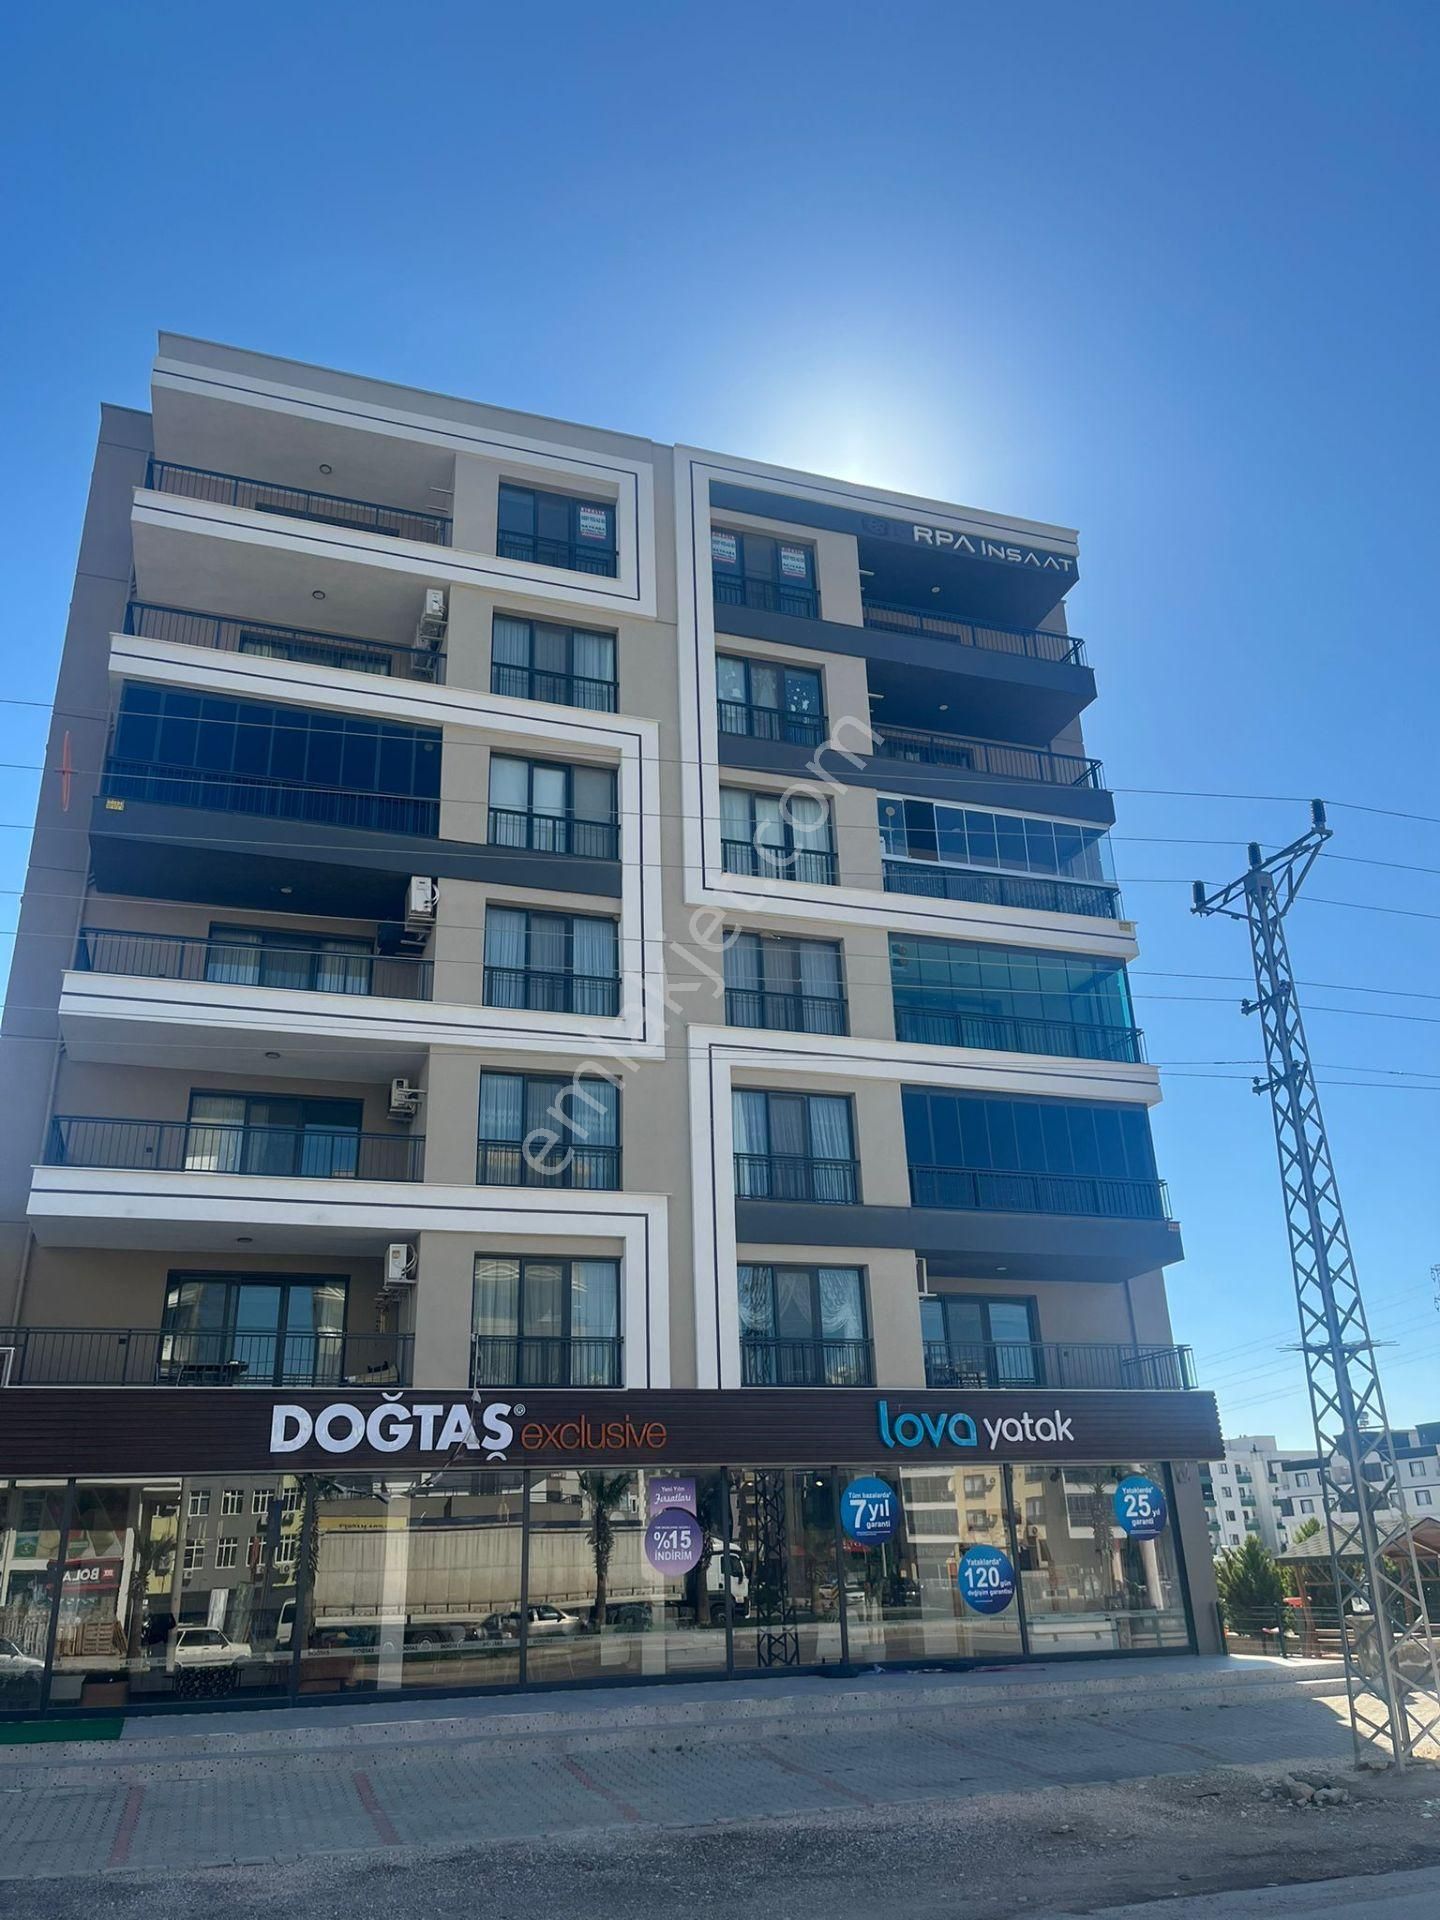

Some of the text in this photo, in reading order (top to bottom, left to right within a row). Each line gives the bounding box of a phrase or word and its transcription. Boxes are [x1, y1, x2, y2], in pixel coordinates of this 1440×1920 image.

[913, 525, 975, 554] RPA
[521, 1414, 667, 1450] exclusive
[879, 1400, 1075, 1450] lova yatak
[849, 1499, 890, 1529] 7 yıl
[1123, 1494, 1151, 1517] 25
[866, 1520, 891, 1530] garanti
[1131, 1518, 1154, 1527] garanti
[653, 1530, 692, 1550] %15
[654, 1549, 692, 1561] İNDİRİM
[964, 1566, 1000, 1588] 120
